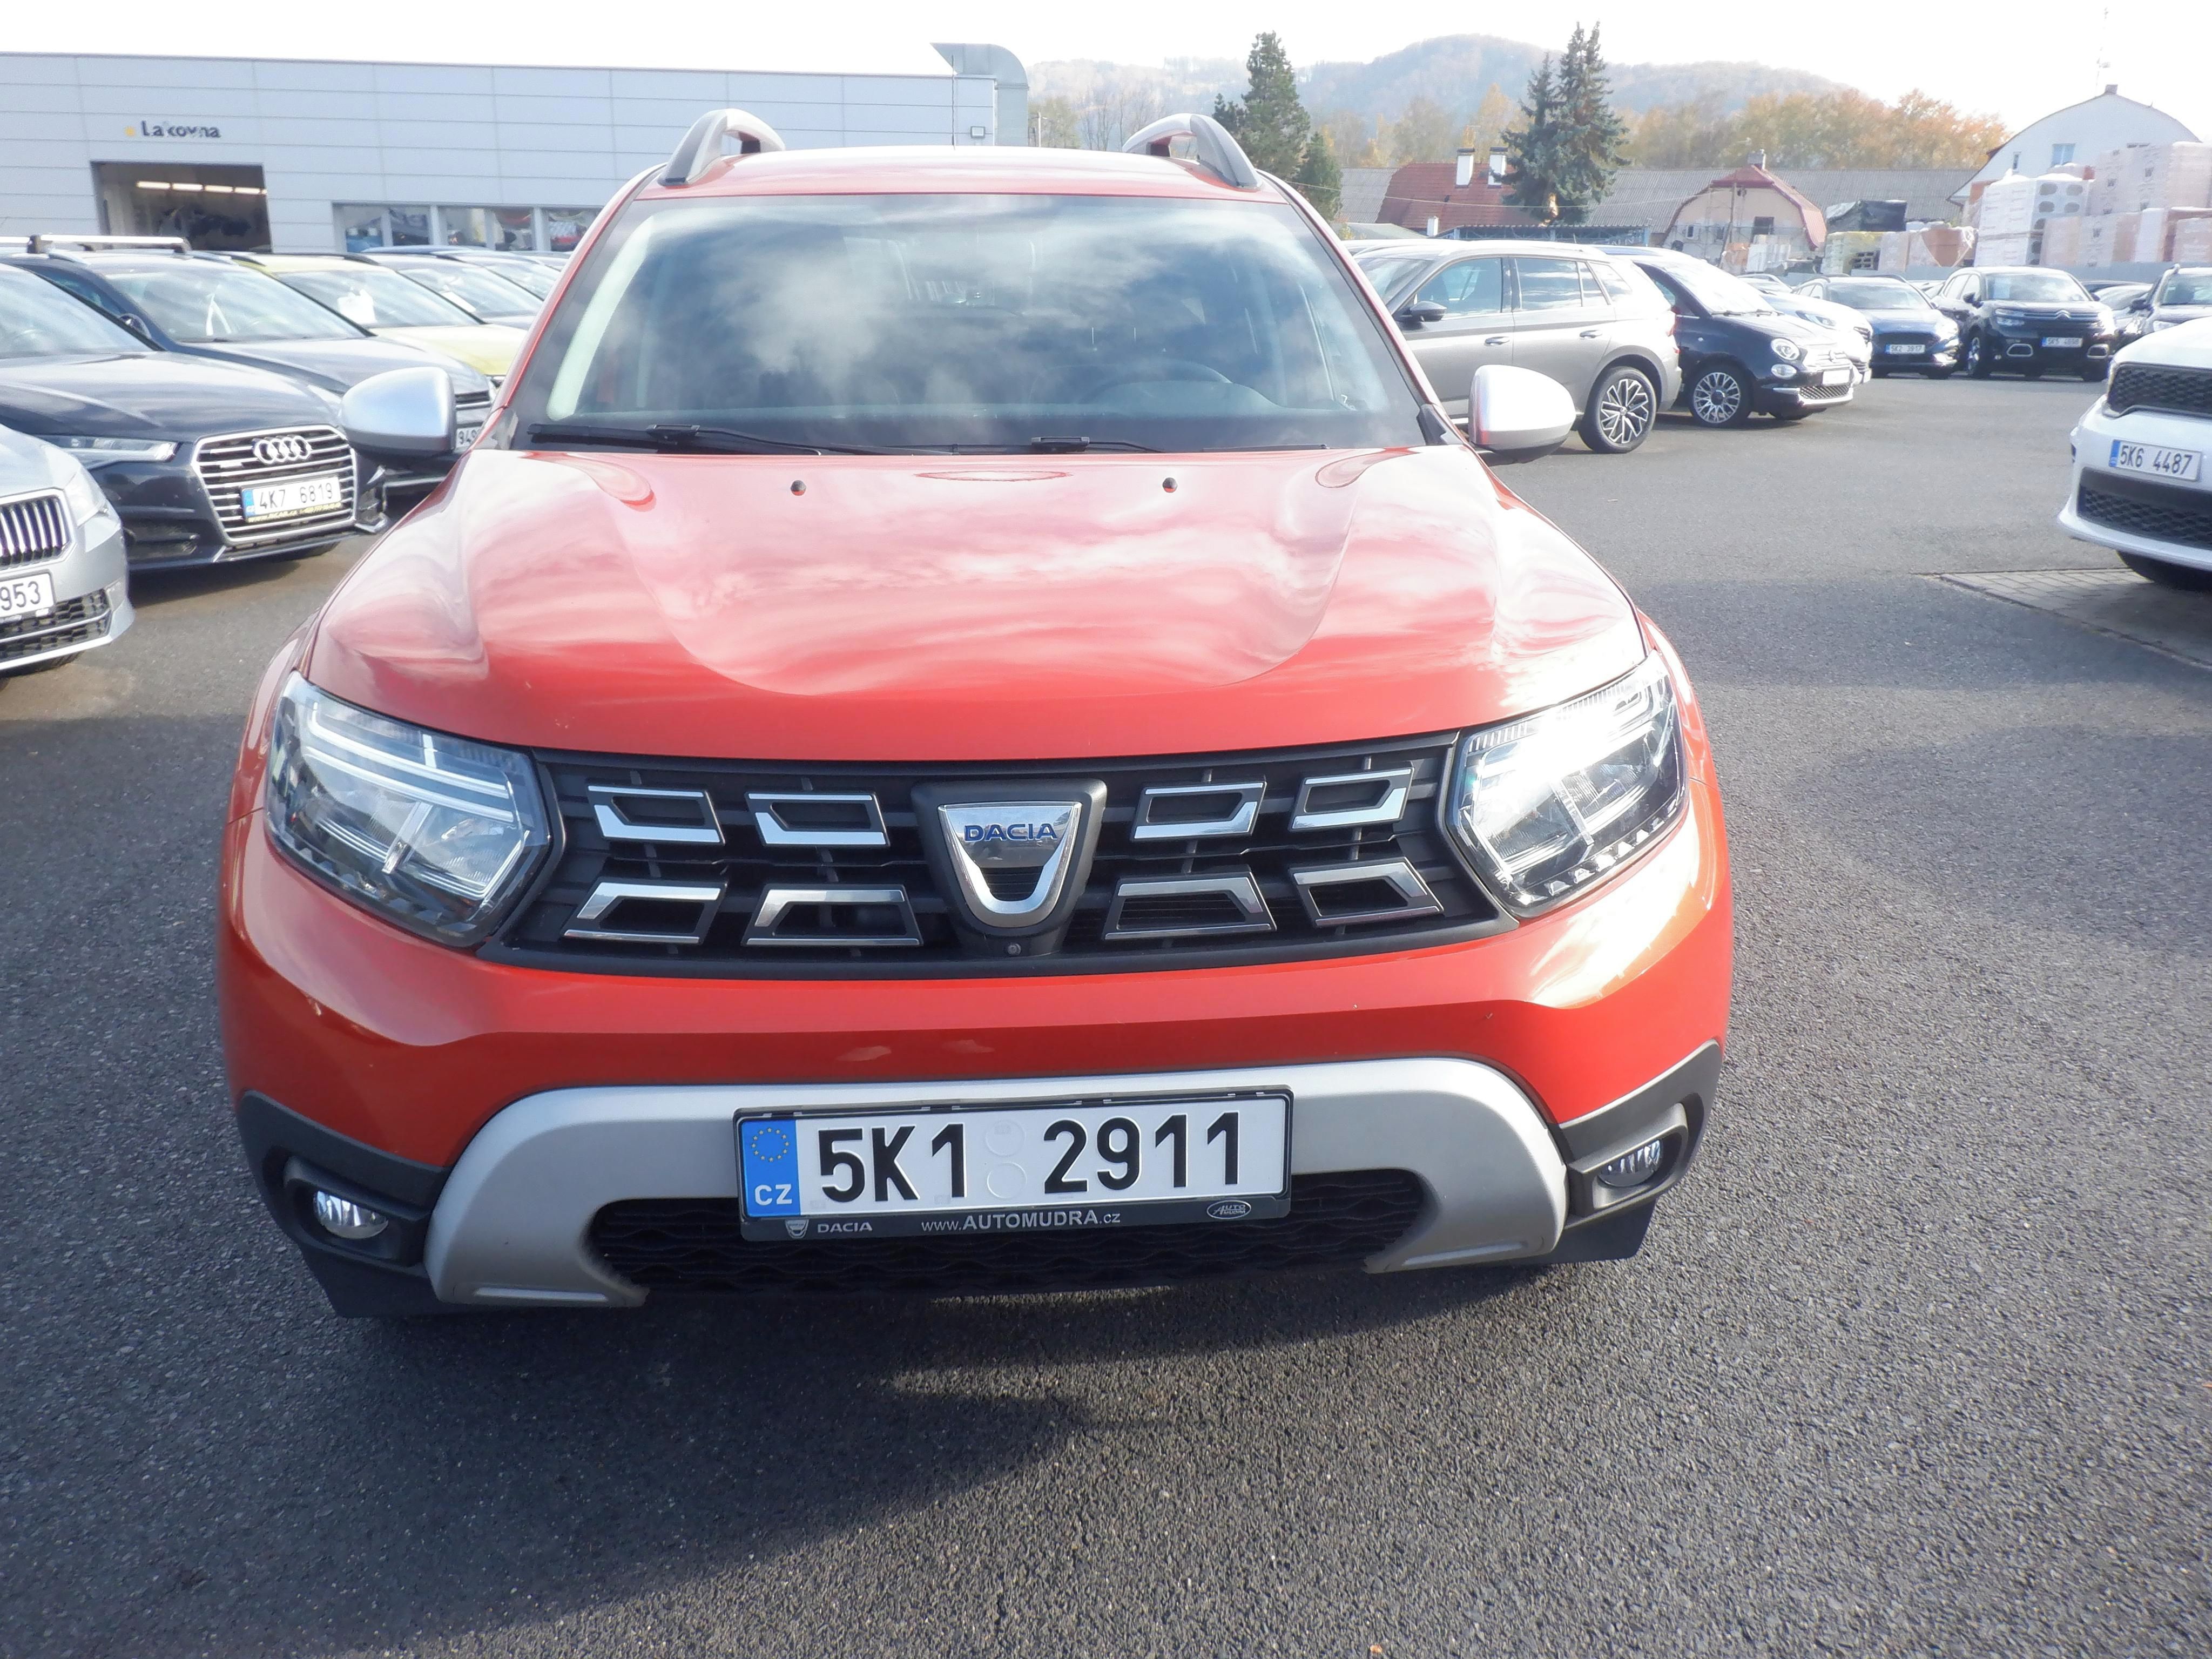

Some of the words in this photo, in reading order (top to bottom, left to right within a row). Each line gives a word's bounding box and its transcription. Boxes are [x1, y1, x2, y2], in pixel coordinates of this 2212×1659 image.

[2120, 444, 2144, 468] 5K6
[2153, 450, 2193, 475] 4487
[260, 489, 286, 509] 4K7
[299, 483, 333, 503] 6819
[964, 823, 1057, 841] DACIA
[818, 1123, 966, 1203] 5K1
[1043, 1112, 1238, 1194] 2911
[755, 1183, 792, 1205] CZ
[817, 1222, 873, 1233] DACIA
[921, 1209, 1120, 1232] www.AUTOMUDRA.cz
